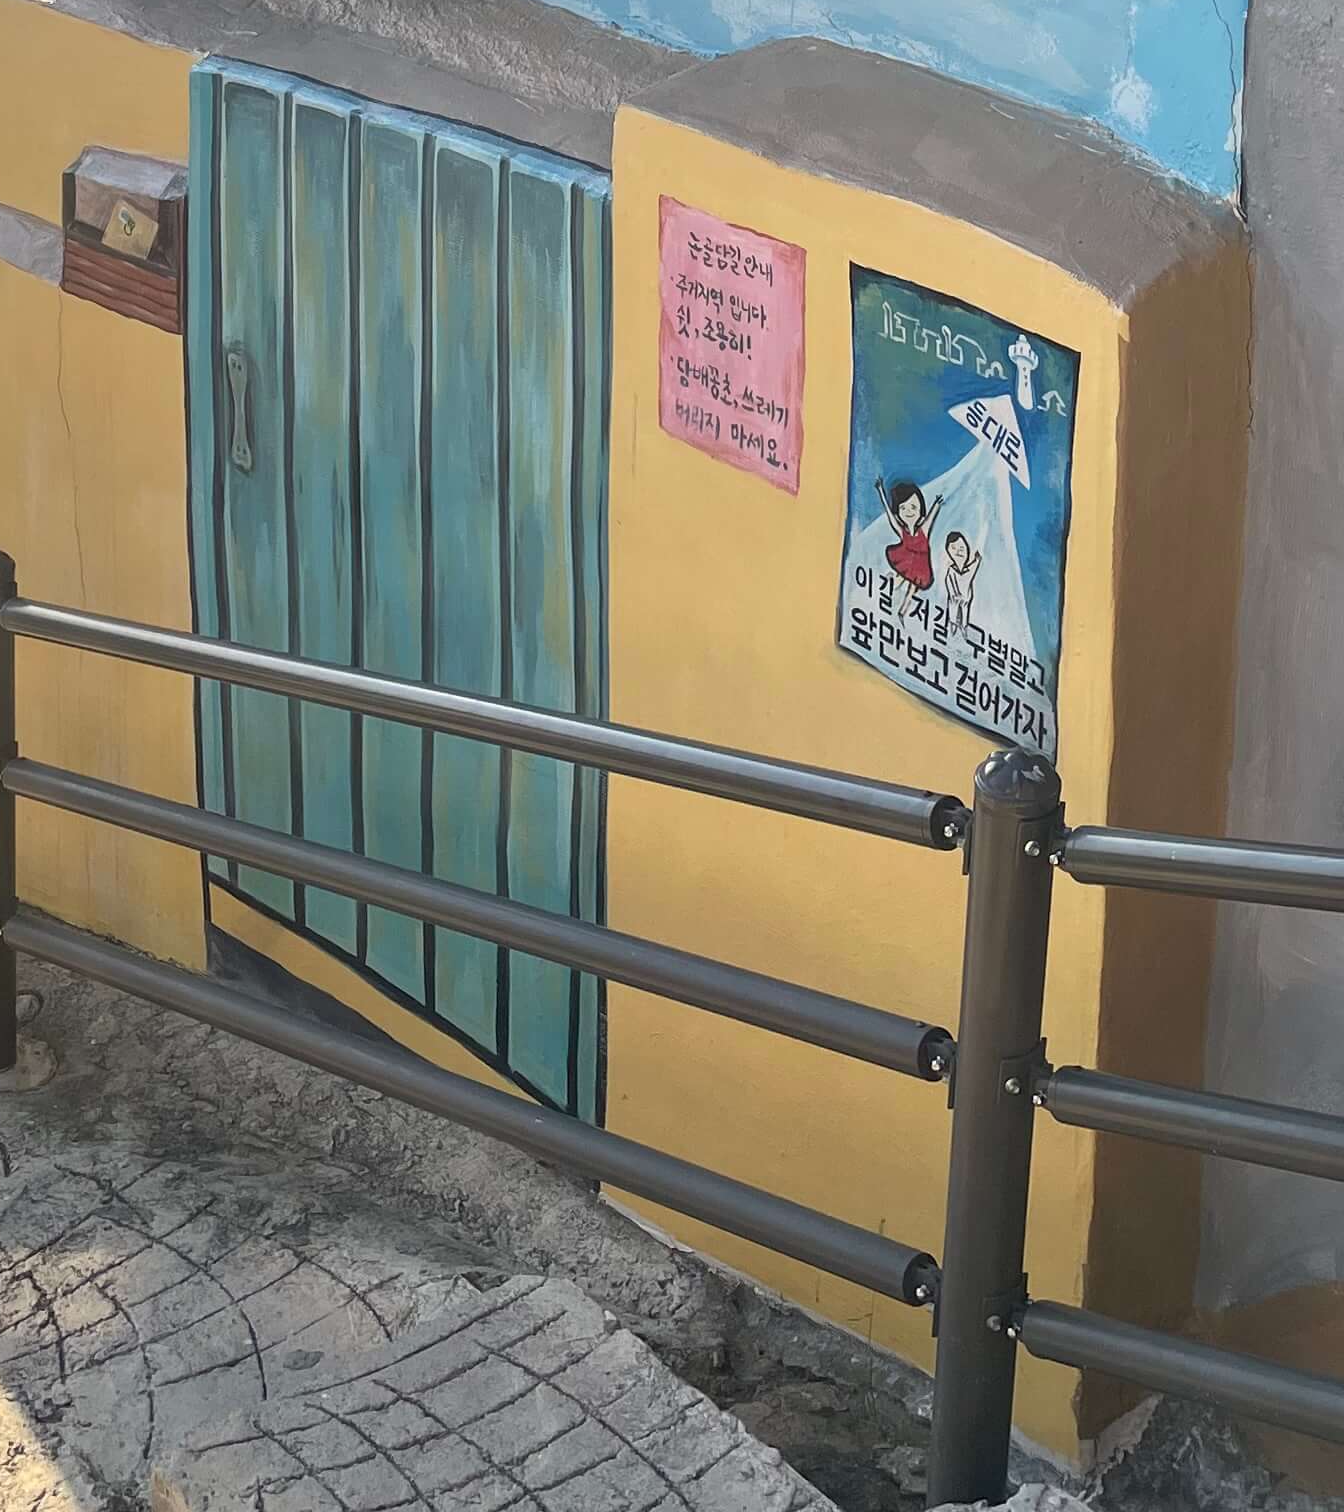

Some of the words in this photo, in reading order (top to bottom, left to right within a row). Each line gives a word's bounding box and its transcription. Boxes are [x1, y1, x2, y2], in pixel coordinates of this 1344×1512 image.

[744, 255, 774, 287] 안내
[702, 316, 752, 360] 조용히!
[674, 398, 721, 440] 버리지
[731, 423, 789, 471] 마세요.
[741, 386, 789, 428] 쓰레기
[966, 399, 1020, 472] 등대로
[850, 607, 949, 695] 앞만보고
[954, 661, 1048, 749] 걸어가자
